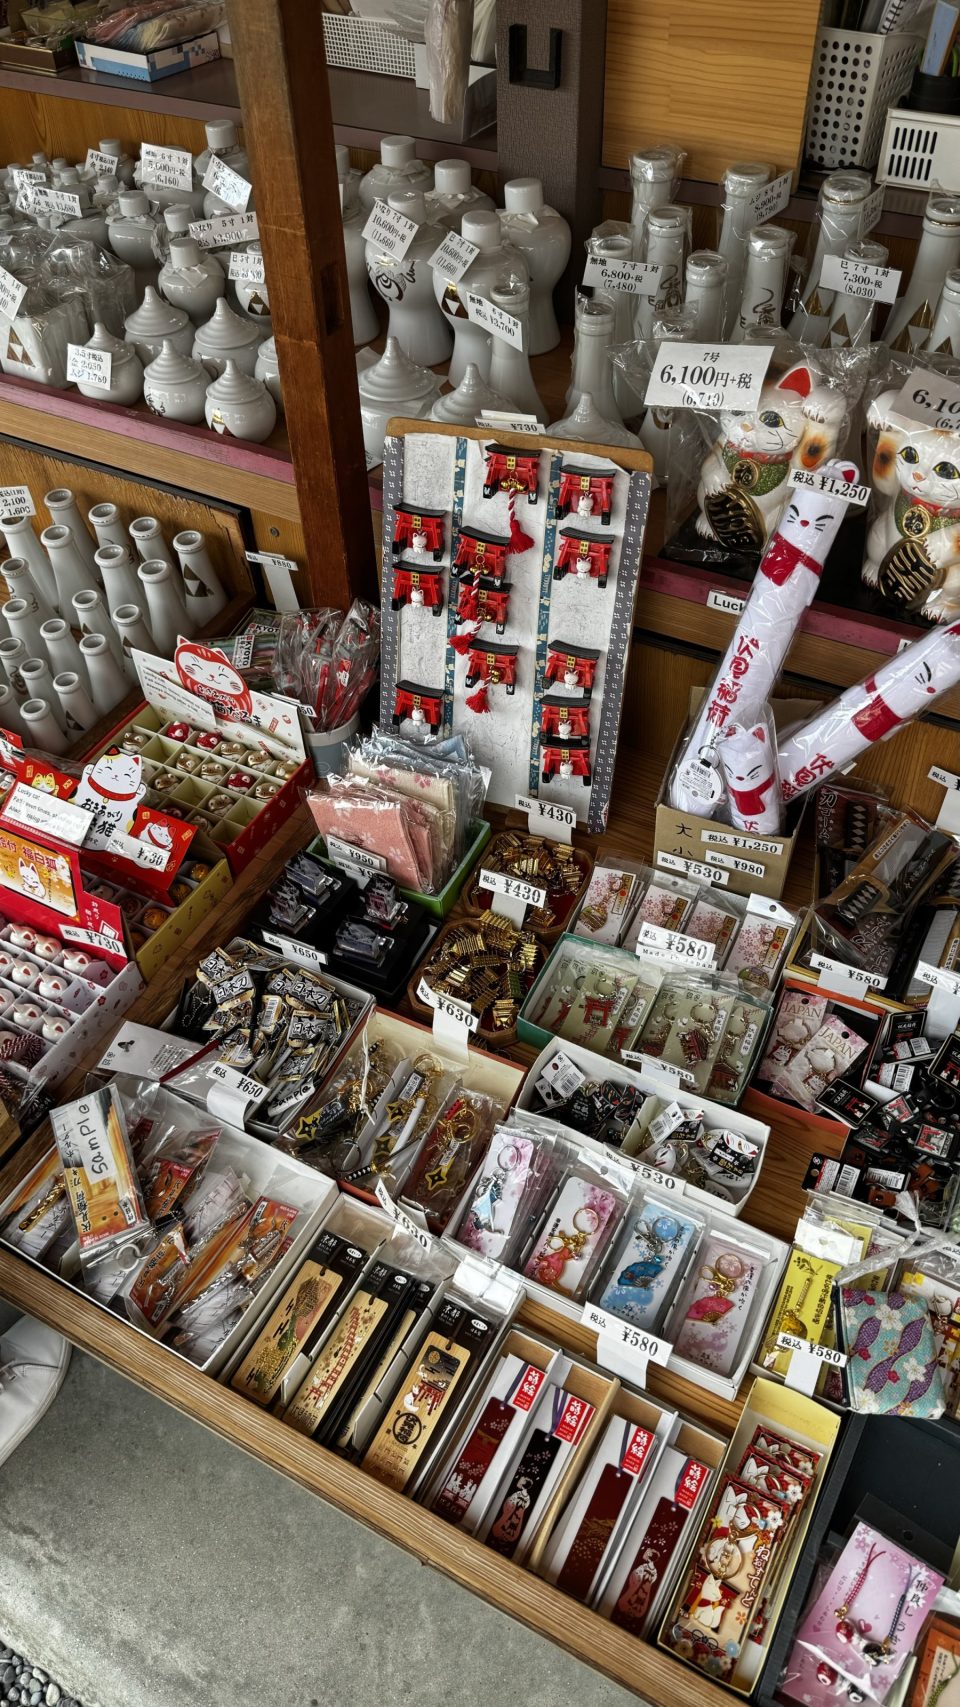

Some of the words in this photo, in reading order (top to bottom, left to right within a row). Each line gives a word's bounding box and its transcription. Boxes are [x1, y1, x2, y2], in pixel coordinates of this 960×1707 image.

[590, 257, 607, 266] 無地
[622, 262, 638, 271] 7寸
[644, 265, 660, 273] 1対
[603, 279, 637, 292] (7,480)
[844, 283, 877, 299] (8,030)
[703, 351, 720, 362] 7号
[510, 424, 538, 432] ¥730
[792, 471, 815, 486] 税込
[819, 477, 868, 502] ¥1,250
[2, 497, 26, 507] 2,100
[243, 641, 253, 666] KYOTO
[538, 803, 573, 825] ¥430
[818, 791, 838, 840] 刀コーム
[675, 822, 694, 839] 大
[707, 834, 728, 844] 税込
[732, 837, 778, 854] ¥1,250
[348, 849, 374, 866] ¥950
[734, 860, 763, 876] ¥980
[684, 861, 723, 882] ¥530
[504, 879, 541, 903] ¥430
[85, 930, 121, 953] ¥730
[291, 942, 318, 961] ¥650
[665, 933, 708, 961] ¥580
[817, 960, 833, 971] 税込
[847, 969, 881, 987] ¥580
[216, 976, 248, 999] 日本刀
[293, 984, 327, 1005] 日本刀
[436, 996, 474, 1028] ¥630
[782, 1003, 822, 1018] JAPAN
[818, 1027, 857, 1059] JAPAN
[212, 1065, 227, 1078] 税込
[236, 1077, 264, 1098] ¥650
[660, 1063, 693, 1082] ¥580
[271, 1083, 312, 1109] Sample
[76, 1103, 109, 1175] Sample
[630, 1162, 676, 1190] ¥530
[319, 1233, 338, 1248] 京都
[393, 1211, 428, 1248] ¥630
[441, 1303, 462, 1319] 京都
[589, 1312, 607, 1328] 税込
[620, 1326, 660, 1357] ¥580
[781, 1336, 802, 1350] 税込
[808, 1344, 841, 1363] ¥580
[522, 1368, 541, 1397] 蒔絵
[564, 1395, 583, 1428] 蒔絵
[631, 1428, 649, 1460] 蒔絵
[684, 1461, 703, 1493] 蒔絵
